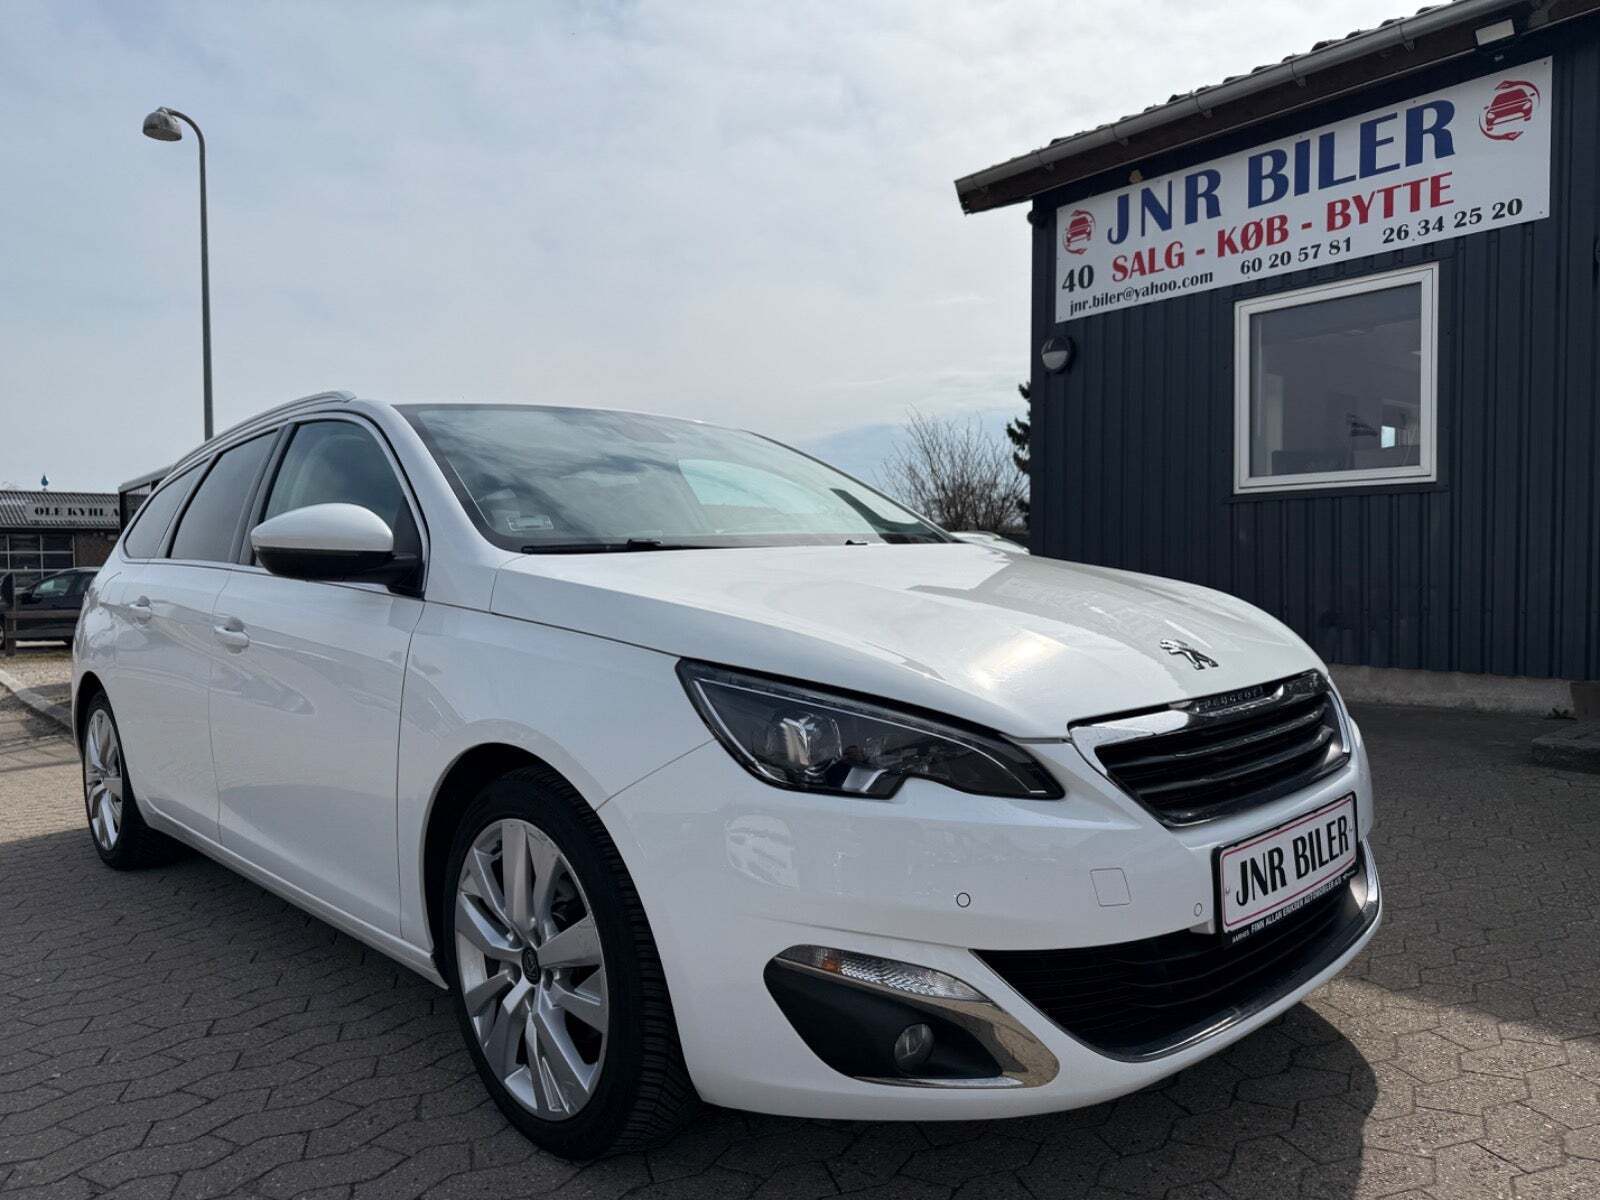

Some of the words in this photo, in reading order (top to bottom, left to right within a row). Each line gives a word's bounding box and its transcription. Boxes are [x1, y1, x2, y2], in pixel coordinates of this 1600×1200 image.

[1107, 168, 1221, 245] JNR
[1247, 99, 1456, 209] BILER
[1112, 240, 1185, 283] SALG
[1217, 214, 1289, 259] KØB
[1326, 171, 1455, 232] BYTTE
[1382, 224, 1410, 245] 26
[1416, 216, 1445, 237] 34
[1453, 208, 1483, 229] 25
[1492, 198, 1523, 220] 20
[1061, 264, 1095, 293] 40
[1240, 257, 1263, 275] 60
[1268, 250, 1292, 269] 20
[1297, 243, 1322, 262] 57
[1328, 236, 1351, 256] 81
[1069, 271, 1214, 316] jnr.biler@yahoo.com
[34, 507, 62, 516] OLE
[1236, 846, 1288, 906] JNR
[1292, 815, 1350, 880] BILER
